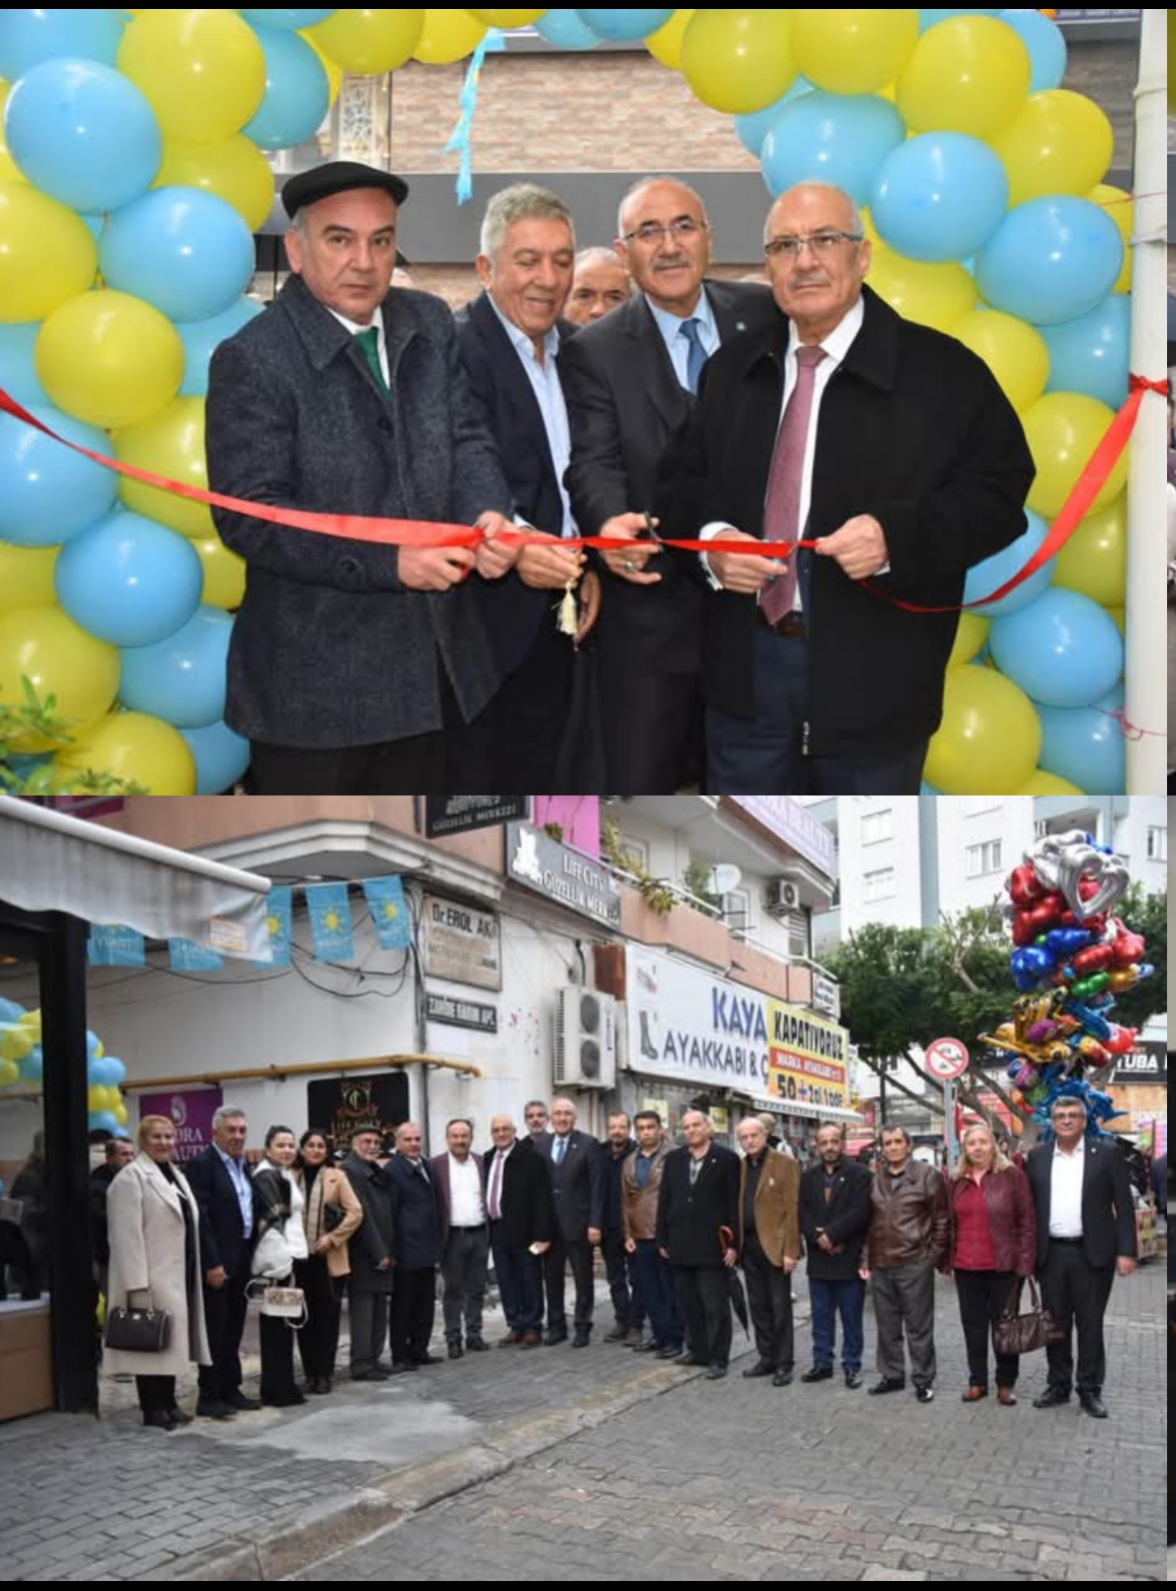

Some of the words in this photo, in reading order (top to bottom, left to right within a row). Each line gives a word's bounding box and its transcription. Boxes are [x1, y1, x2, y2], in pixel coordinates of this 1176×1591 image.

[713, 986, 768, 1041] KAYA
[774, 1010, 844, 1060] KAPATIYORUZ
[663, 1030, 747, 1076] AYAKKABI
[749, 1049, 759, 1077] &
[777, 1073, 796, 1100] 50
